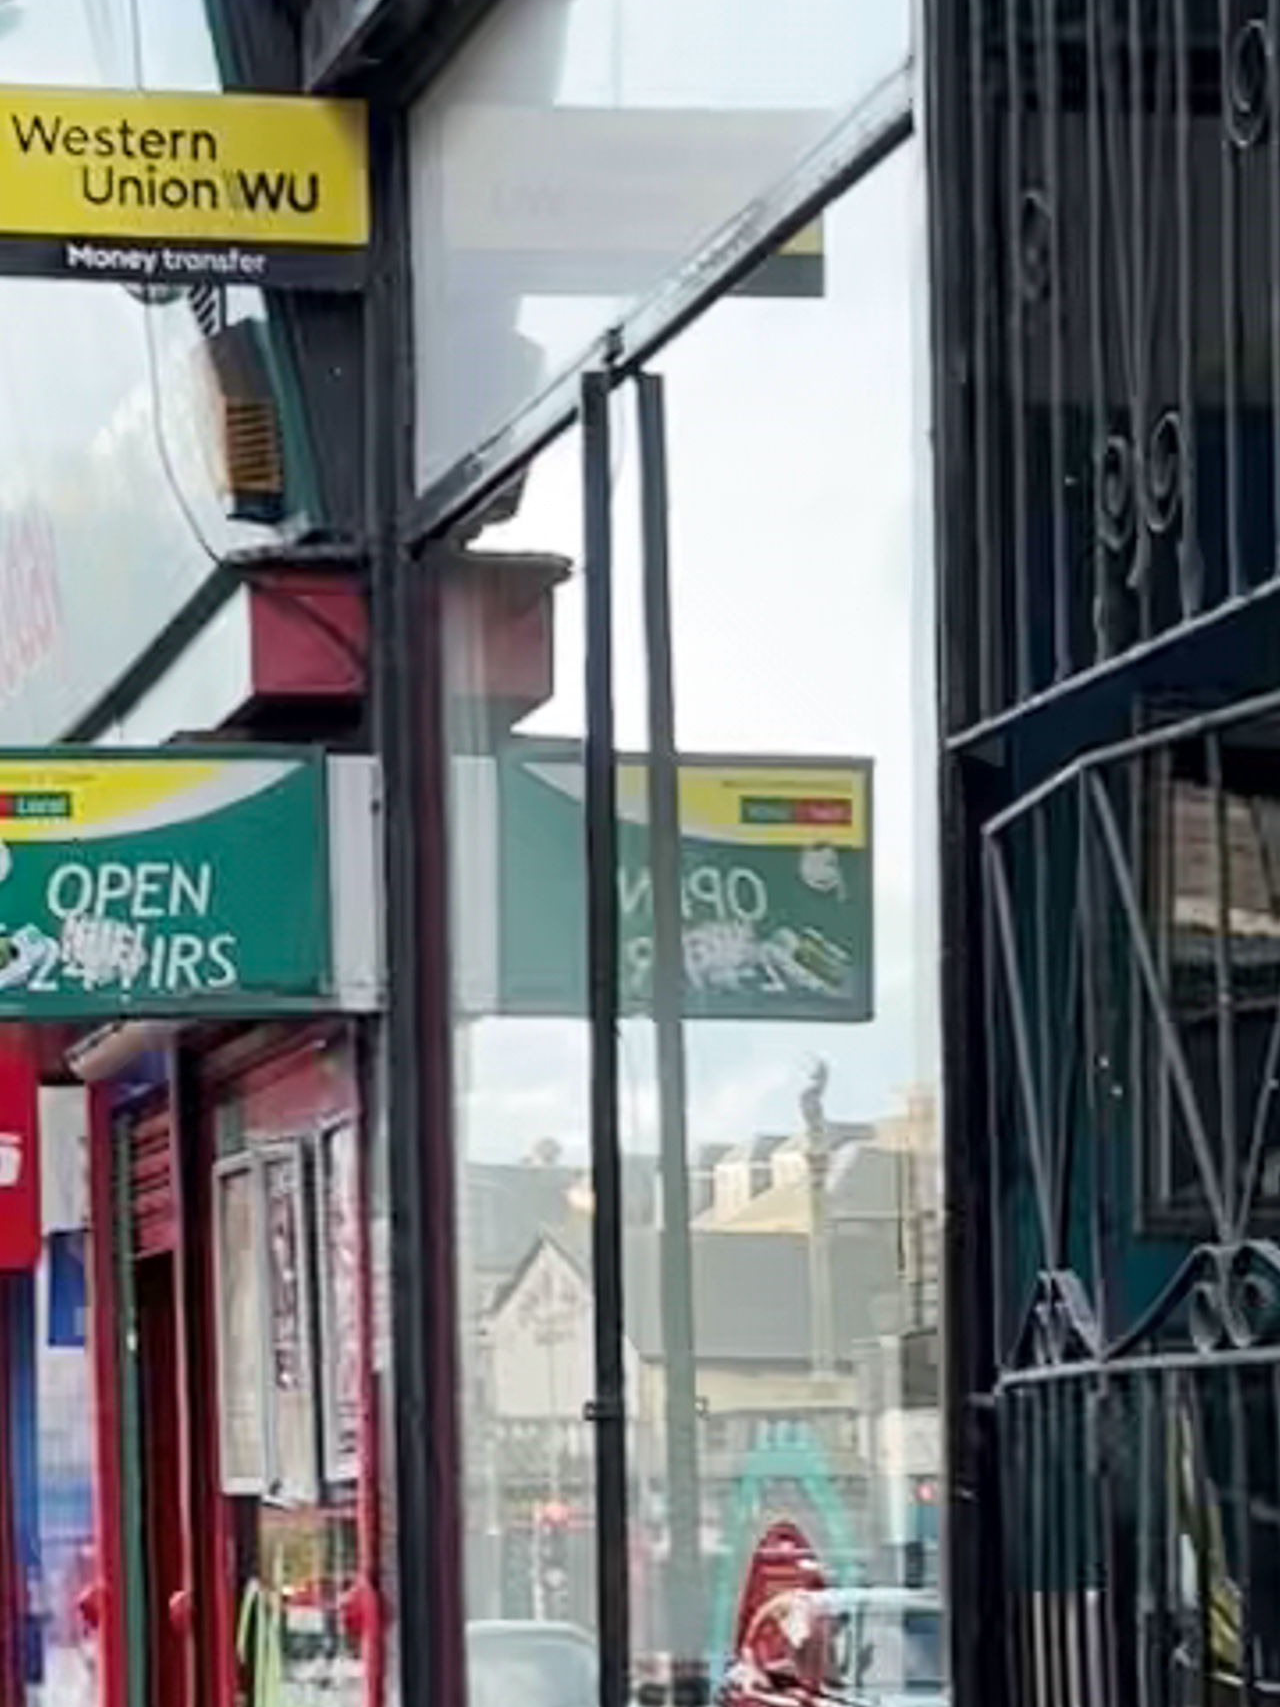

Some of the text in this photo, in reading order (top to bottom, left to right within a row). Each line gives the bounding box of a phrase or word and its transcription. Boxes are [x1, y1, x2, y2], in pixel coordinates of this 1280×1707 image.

[12, 114, 217, 161] Western
[81, 166, 321, 214] Union WU
[66, 243, 266, 275] Money transfer
[46, 862, 211, 919] OPEN
